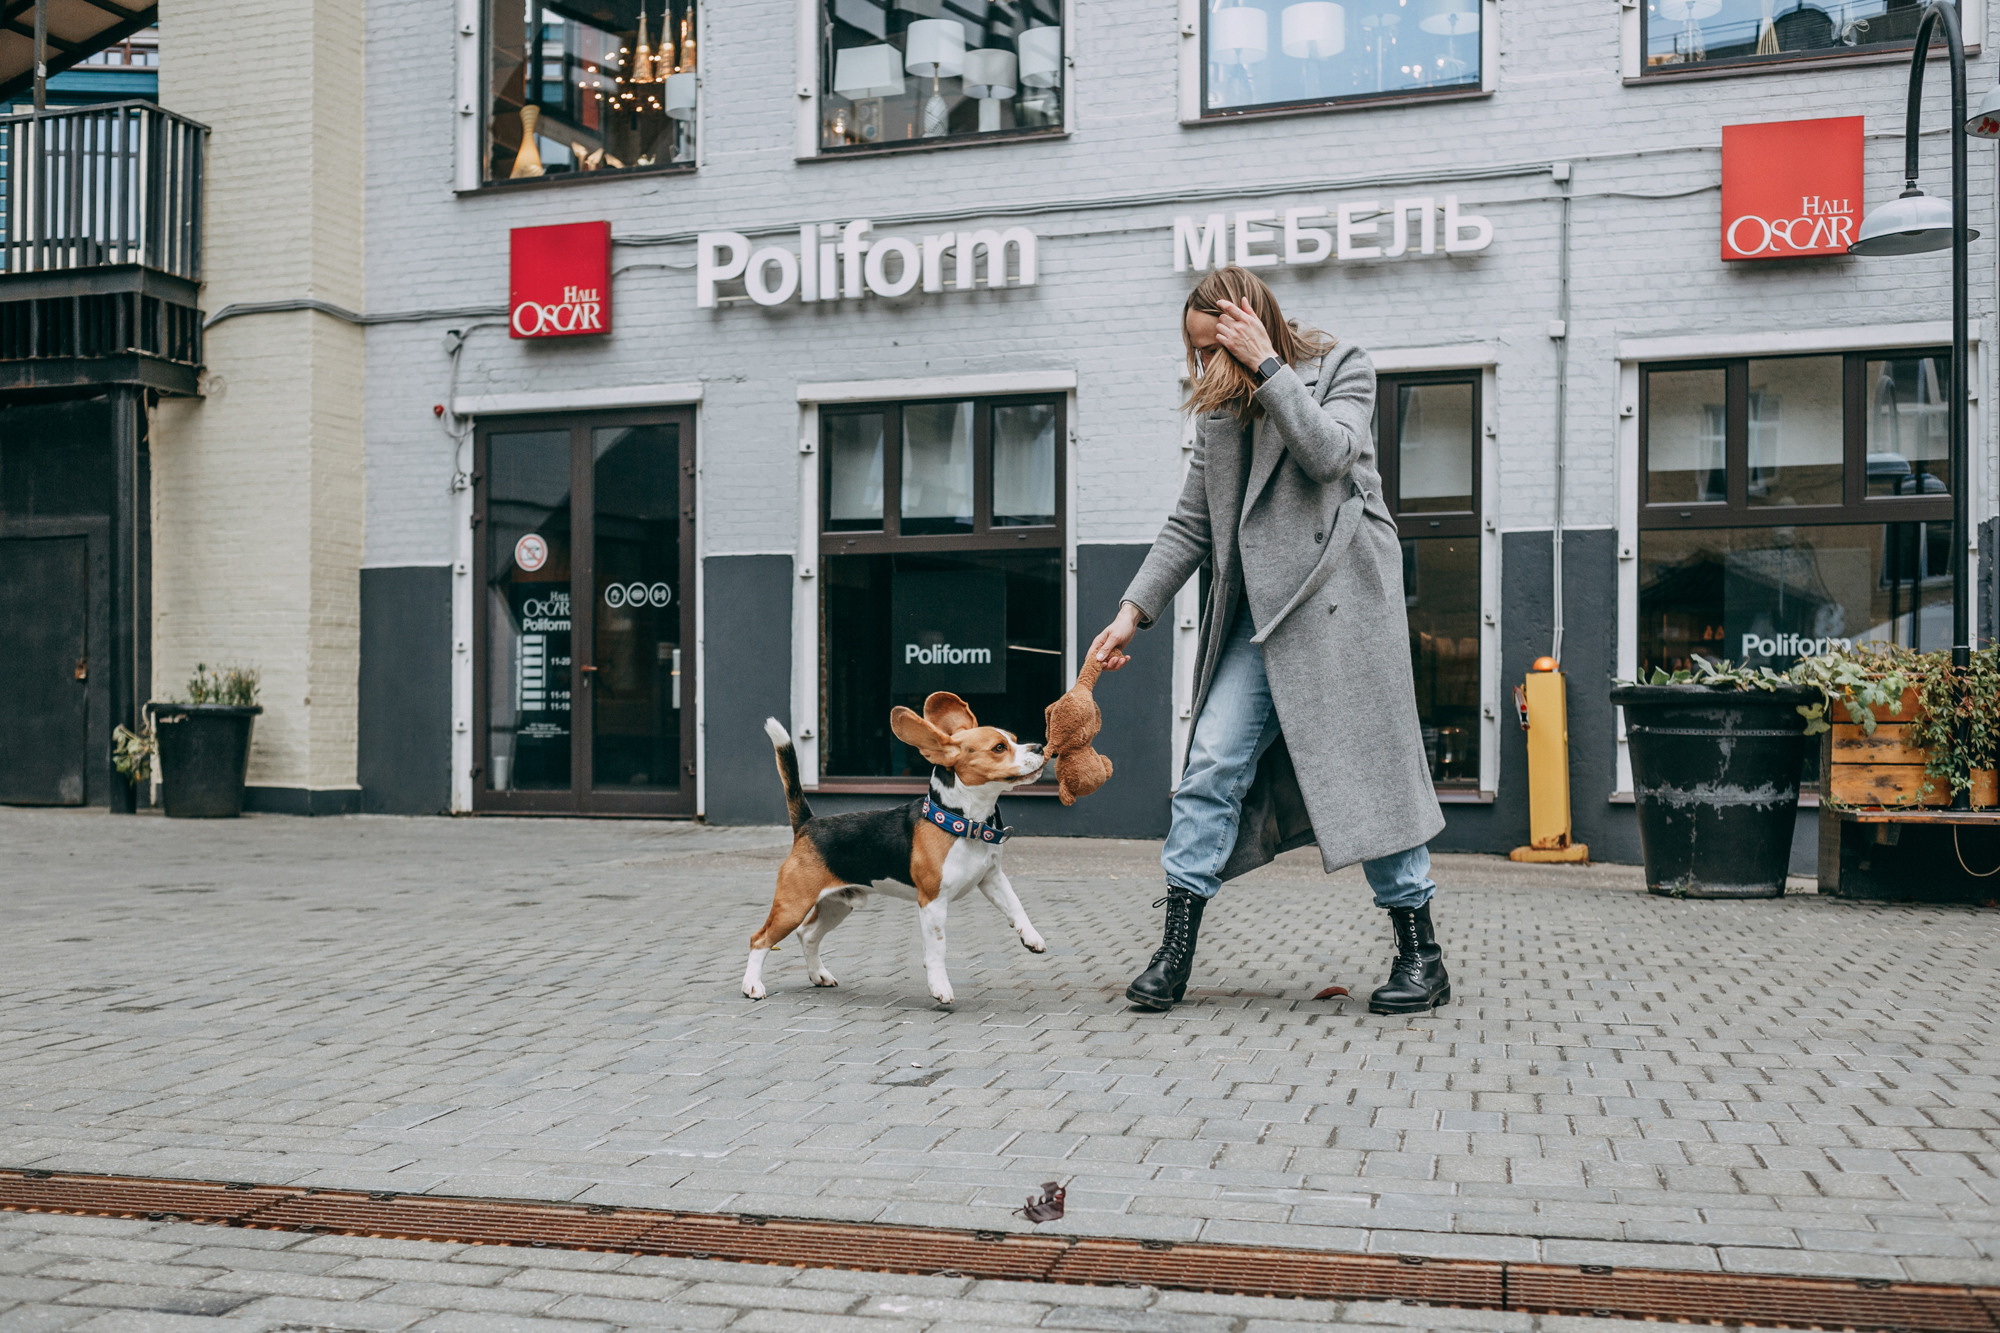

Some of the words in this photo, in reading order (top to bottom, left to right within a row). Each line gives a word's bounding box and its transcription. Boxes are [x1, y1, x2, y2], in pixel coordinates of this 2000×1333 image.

[1802, 195, 1854, 216] HALL
[1173, 194, 1494, 272] МЕБЕЛЬ
[1727, 215, 1855, 255] OSCAR
[697, 219, 1038, 308] Poliform
[563, 285, 600, 304] HALL
[512, 301, 602, 336] OSCAR
[523, 617, 571, 631] Poliform
[905, 643, 991, 664] Poliform
